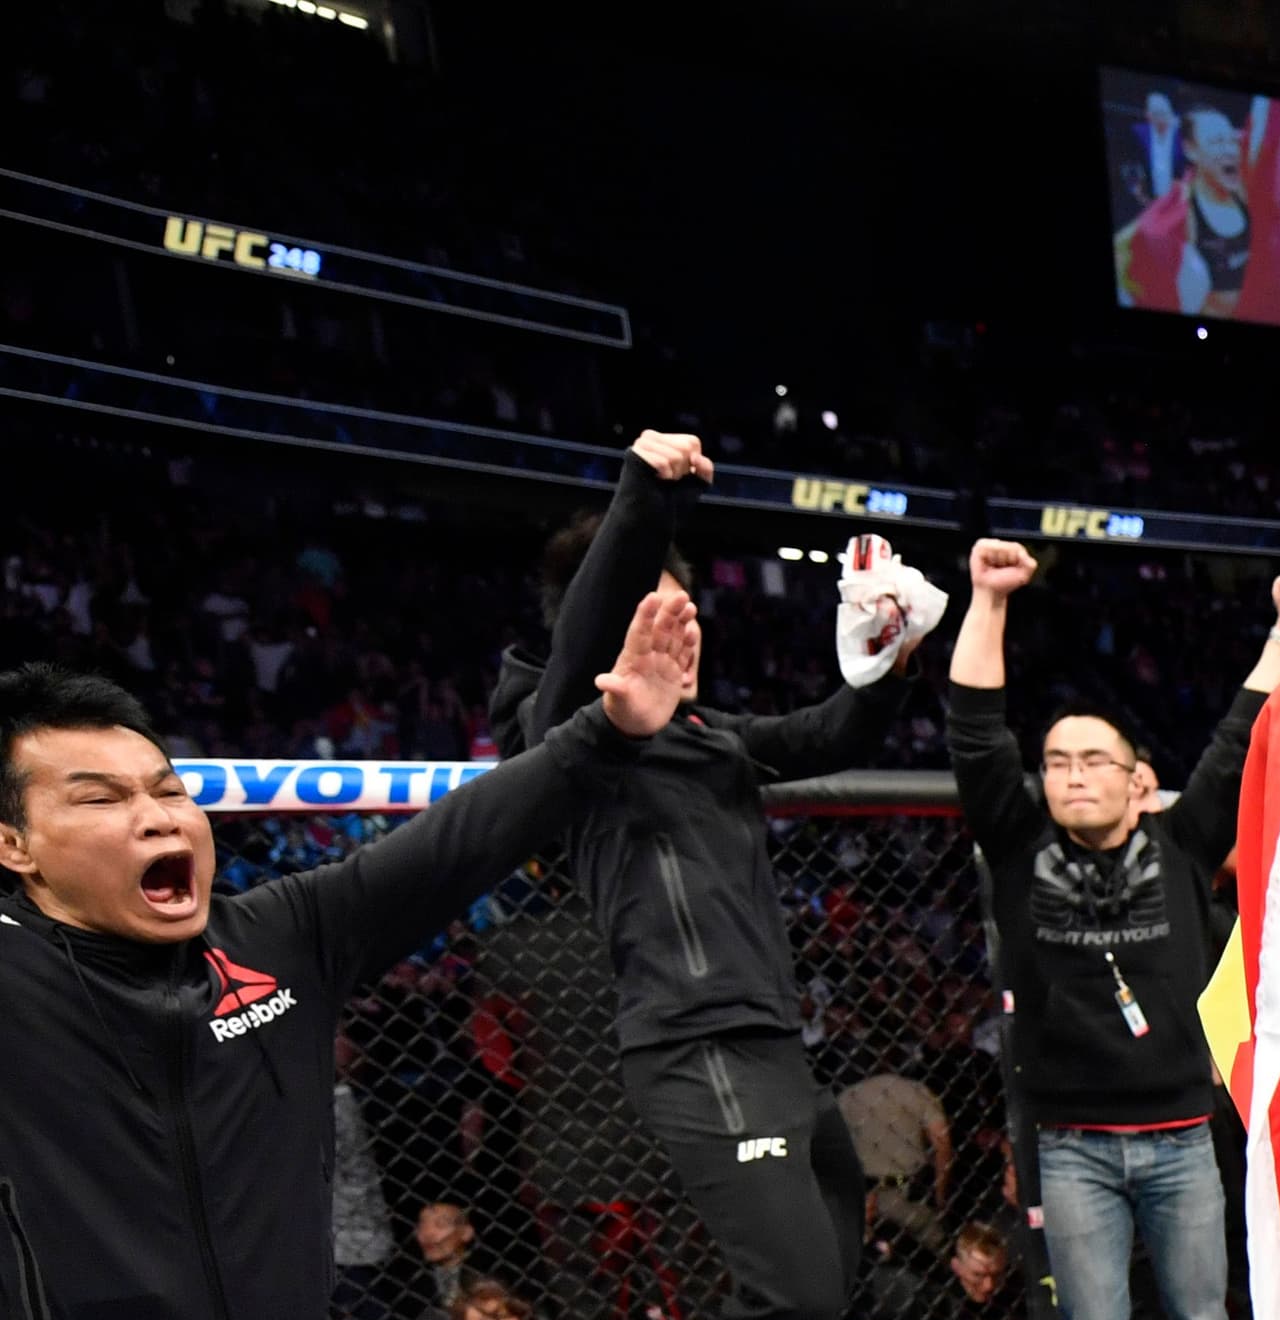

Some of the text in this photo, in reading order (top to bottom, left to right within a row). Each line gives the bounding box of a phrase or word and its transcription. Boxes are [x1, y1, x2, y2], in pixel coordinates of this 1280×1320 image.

[164, 216, 269, 270] UFC
[792, 478, 869, 516] UFC
[1041, 507, 1109, 537] UFC
[738, 1137, 788, 1163] UFC
